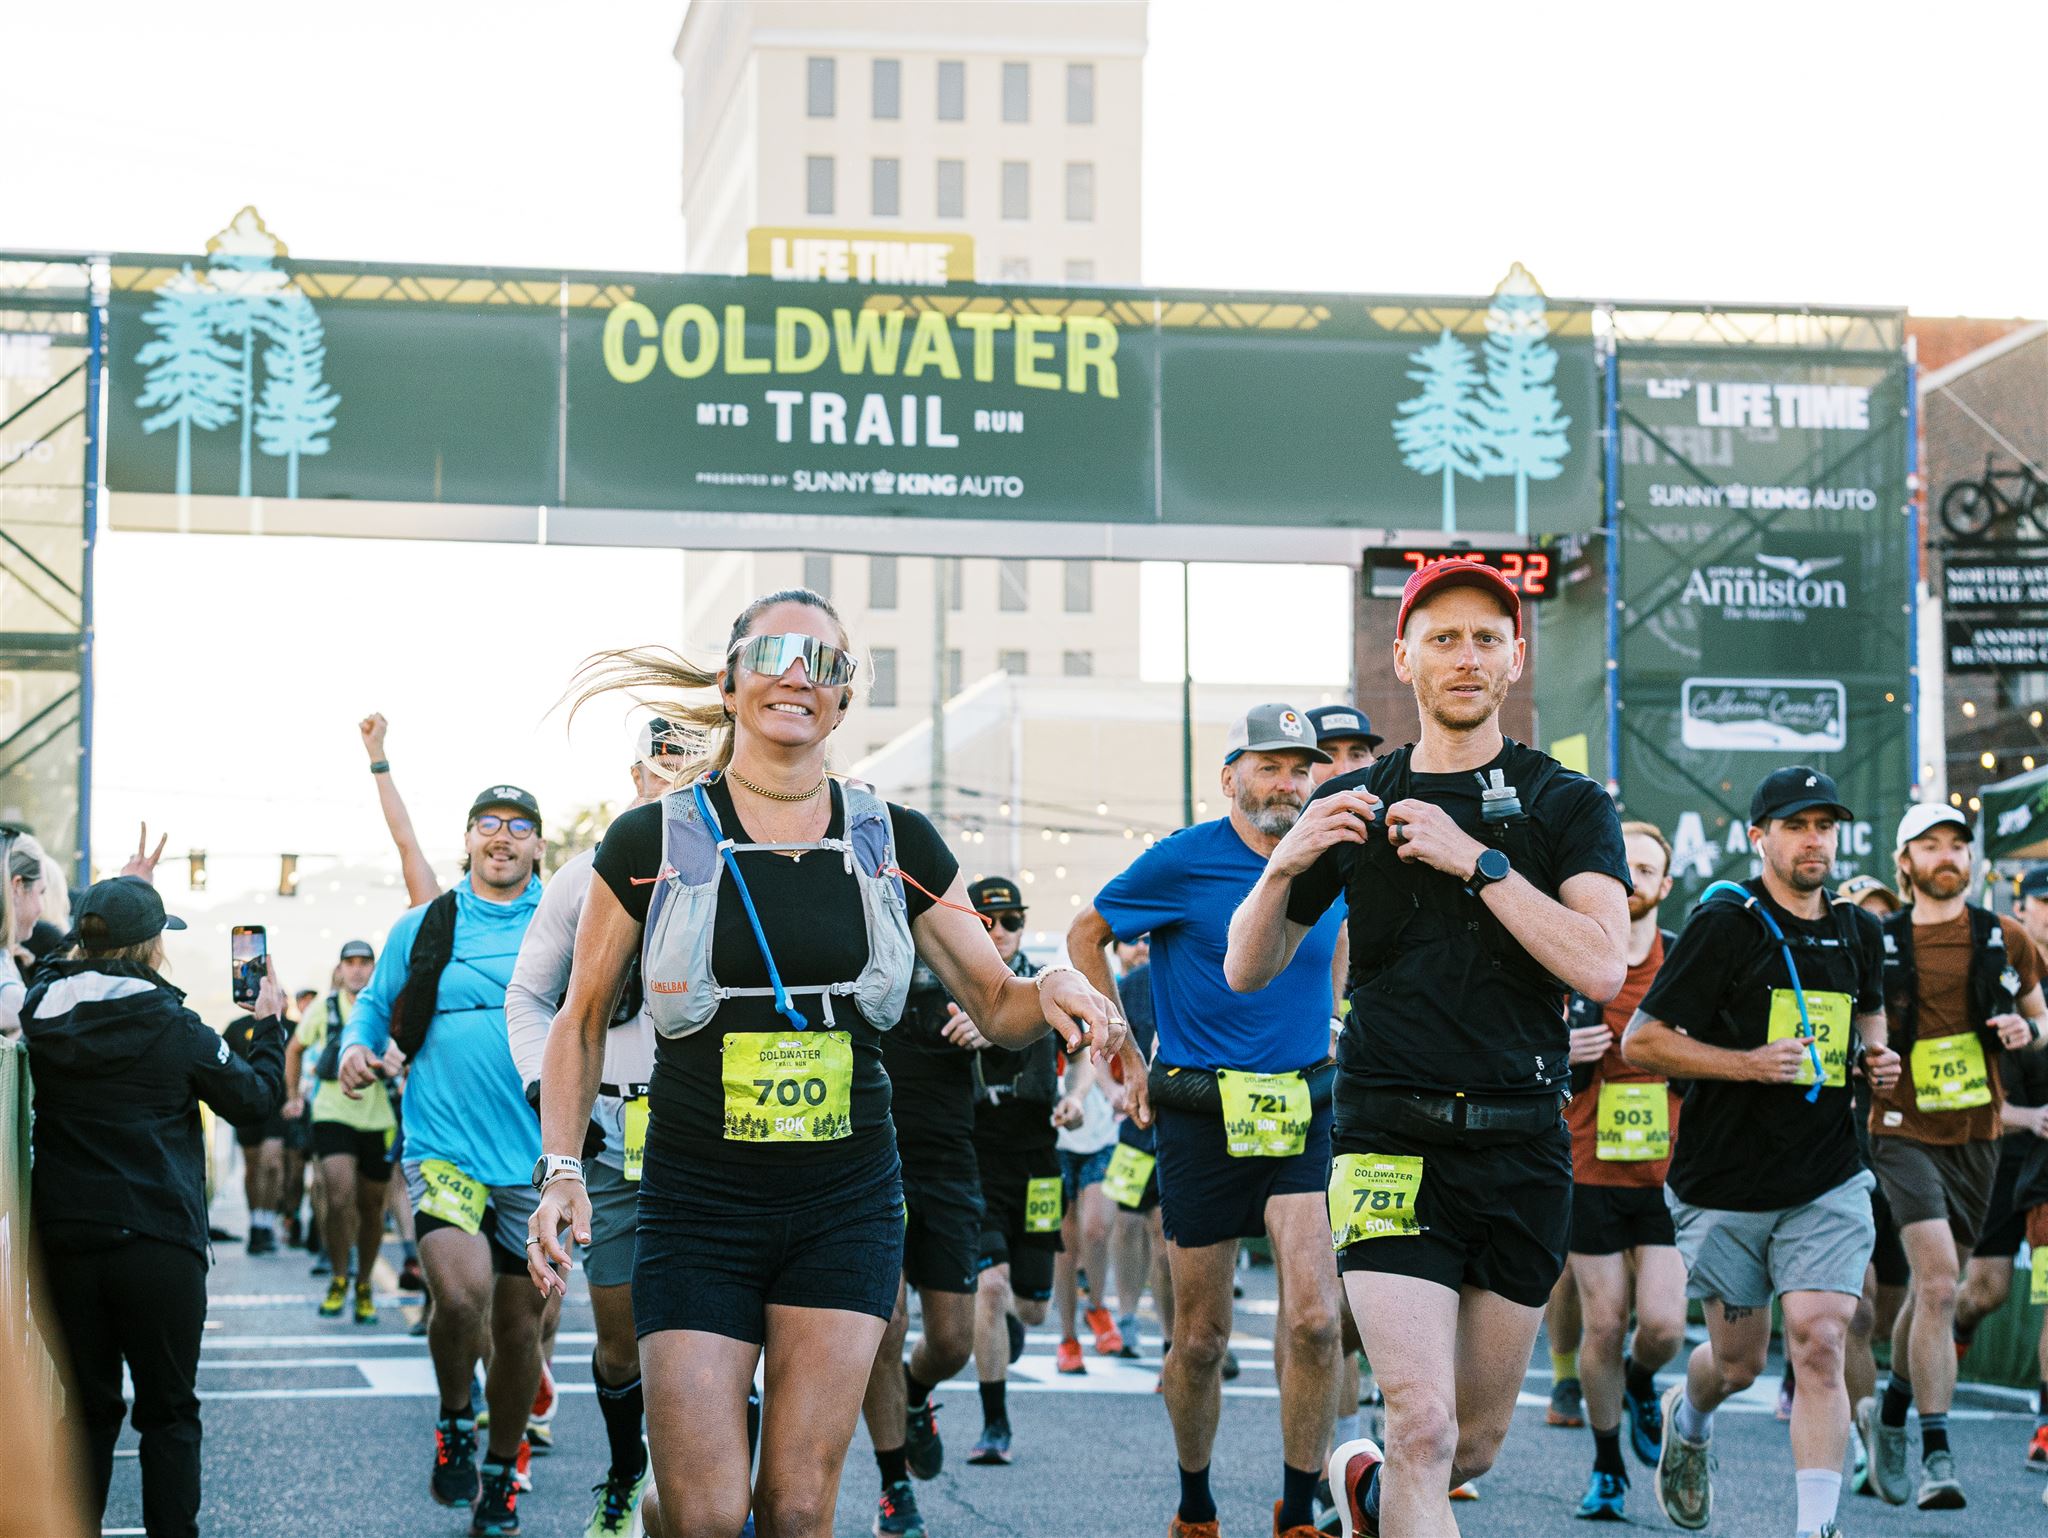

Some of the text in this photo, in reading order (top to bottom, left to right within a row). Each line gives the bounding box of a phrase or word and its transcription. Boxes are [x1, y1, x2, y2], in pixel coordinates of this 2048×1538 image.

[771, 237, 949, 287] LIFE TIME
[603, 300, 1120, 398] COLDWATER
[1697, 382, 1773, 427] LIFE
[1773, 384, 1870, 430] TIME
[696, 389, 1024, 448] MTB TRAIL RUN
[696, 469, 1025, 498] PRESENTED BY SUNNY KING AUTO
[1649, 483, 1878, 511] SUNNY KING AUTO
[1680, 568, 1847, 609] Anniston
[650, 979, 689, 993] CAMELBAK
[1795, 1022, 1831, 1042] 812
[759, 1049, 821, 1062] COLDWATER
[1930, 1060, 1967, 1079] 765
[753, 1077, 827, 1107] 700
[1248, 1094, 1287, 1113] 721
[775, 1116, 807, 1133] 50K
[1614, 1109, 1653, 1126] 903
[1354, 1168, 1414, 1181] COLDWATER
[437, 1172, 474, 1201] 848
[1030, 1200, 1057, 1216] 907
[1352, 1188, 1407, 1214] 781
[1365, 1217, 1397, 1234] 50K
